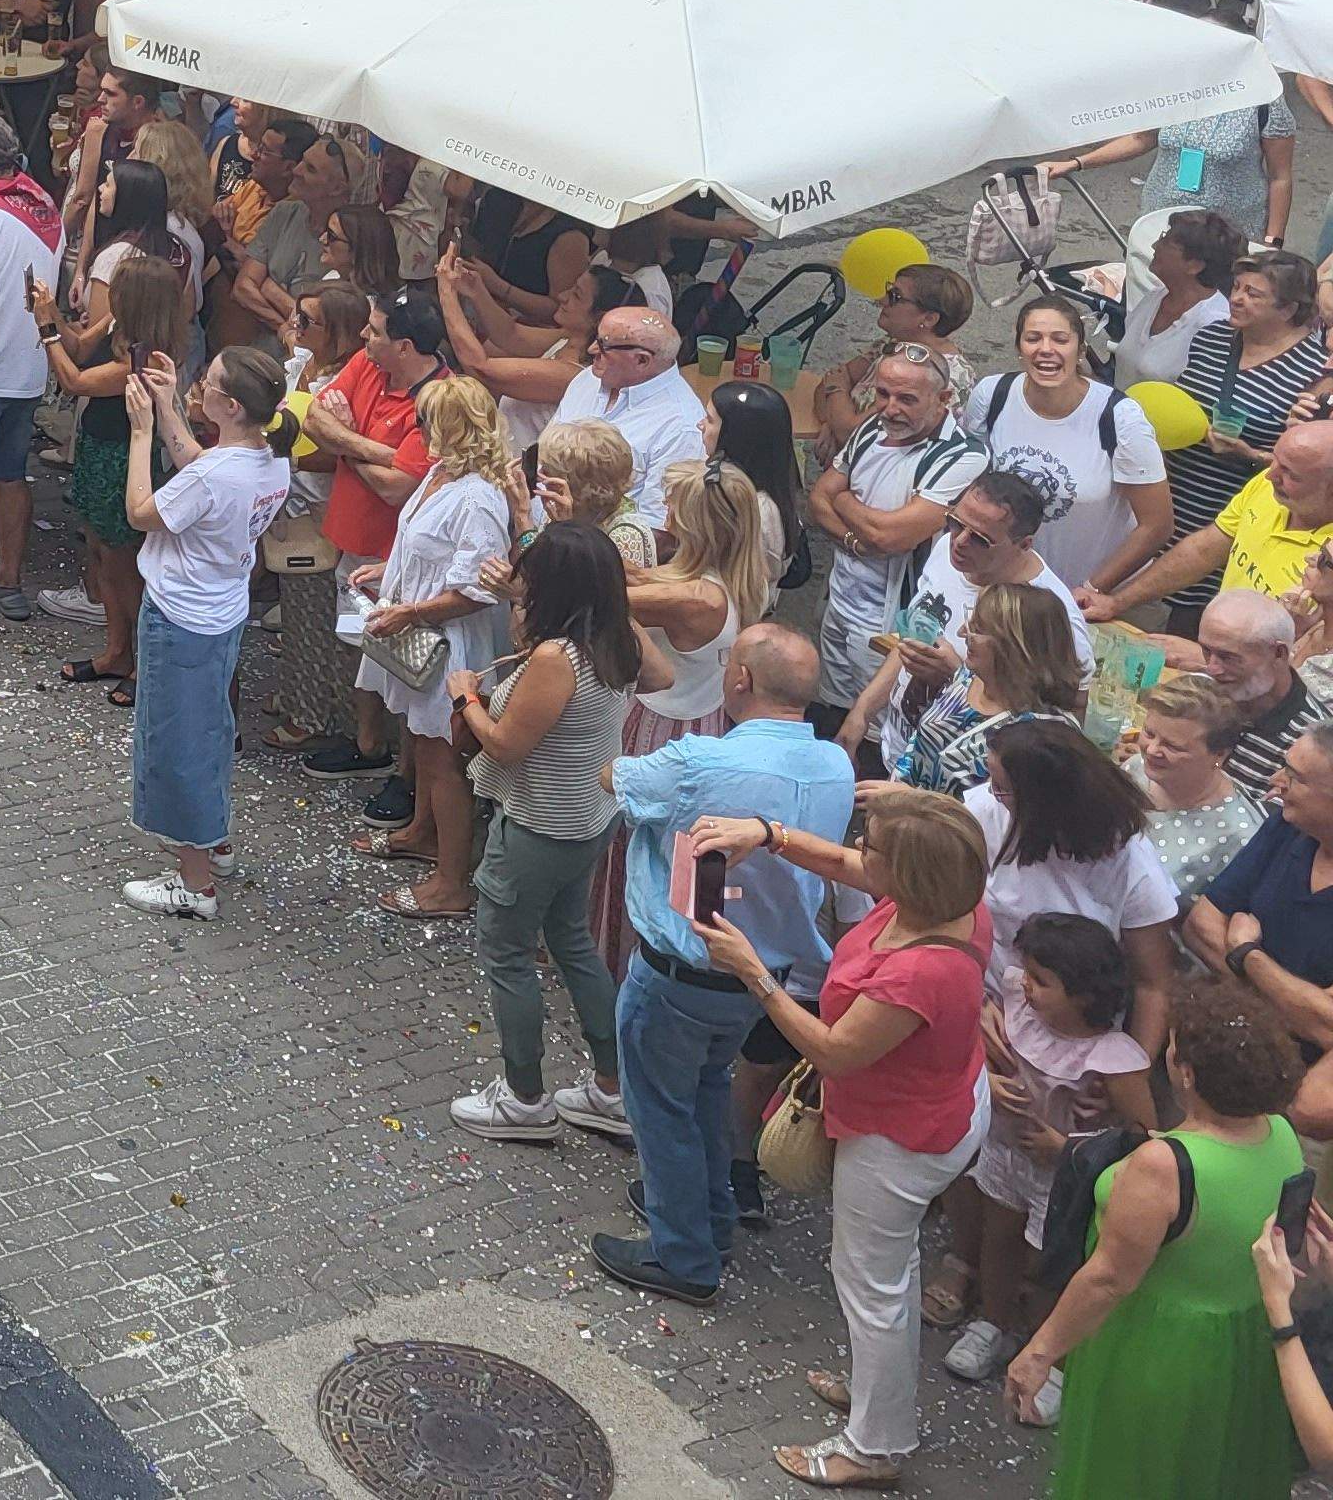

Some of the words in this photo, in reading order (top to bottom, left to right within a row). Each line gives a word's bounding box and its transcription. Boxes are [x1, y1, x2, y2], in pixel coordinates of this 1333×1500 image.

[136, 40, 201, 71] AMBAR
[1071, 102, 1142, 126] CERVECEROS
[1144, 80, 1246, 111] INDEPENDIENTES
[445, 138, 537, 181] CERVECEROS
[541, 173, 621, 213] INDEPENDI
[761, 180, 836, 215] MBAR
